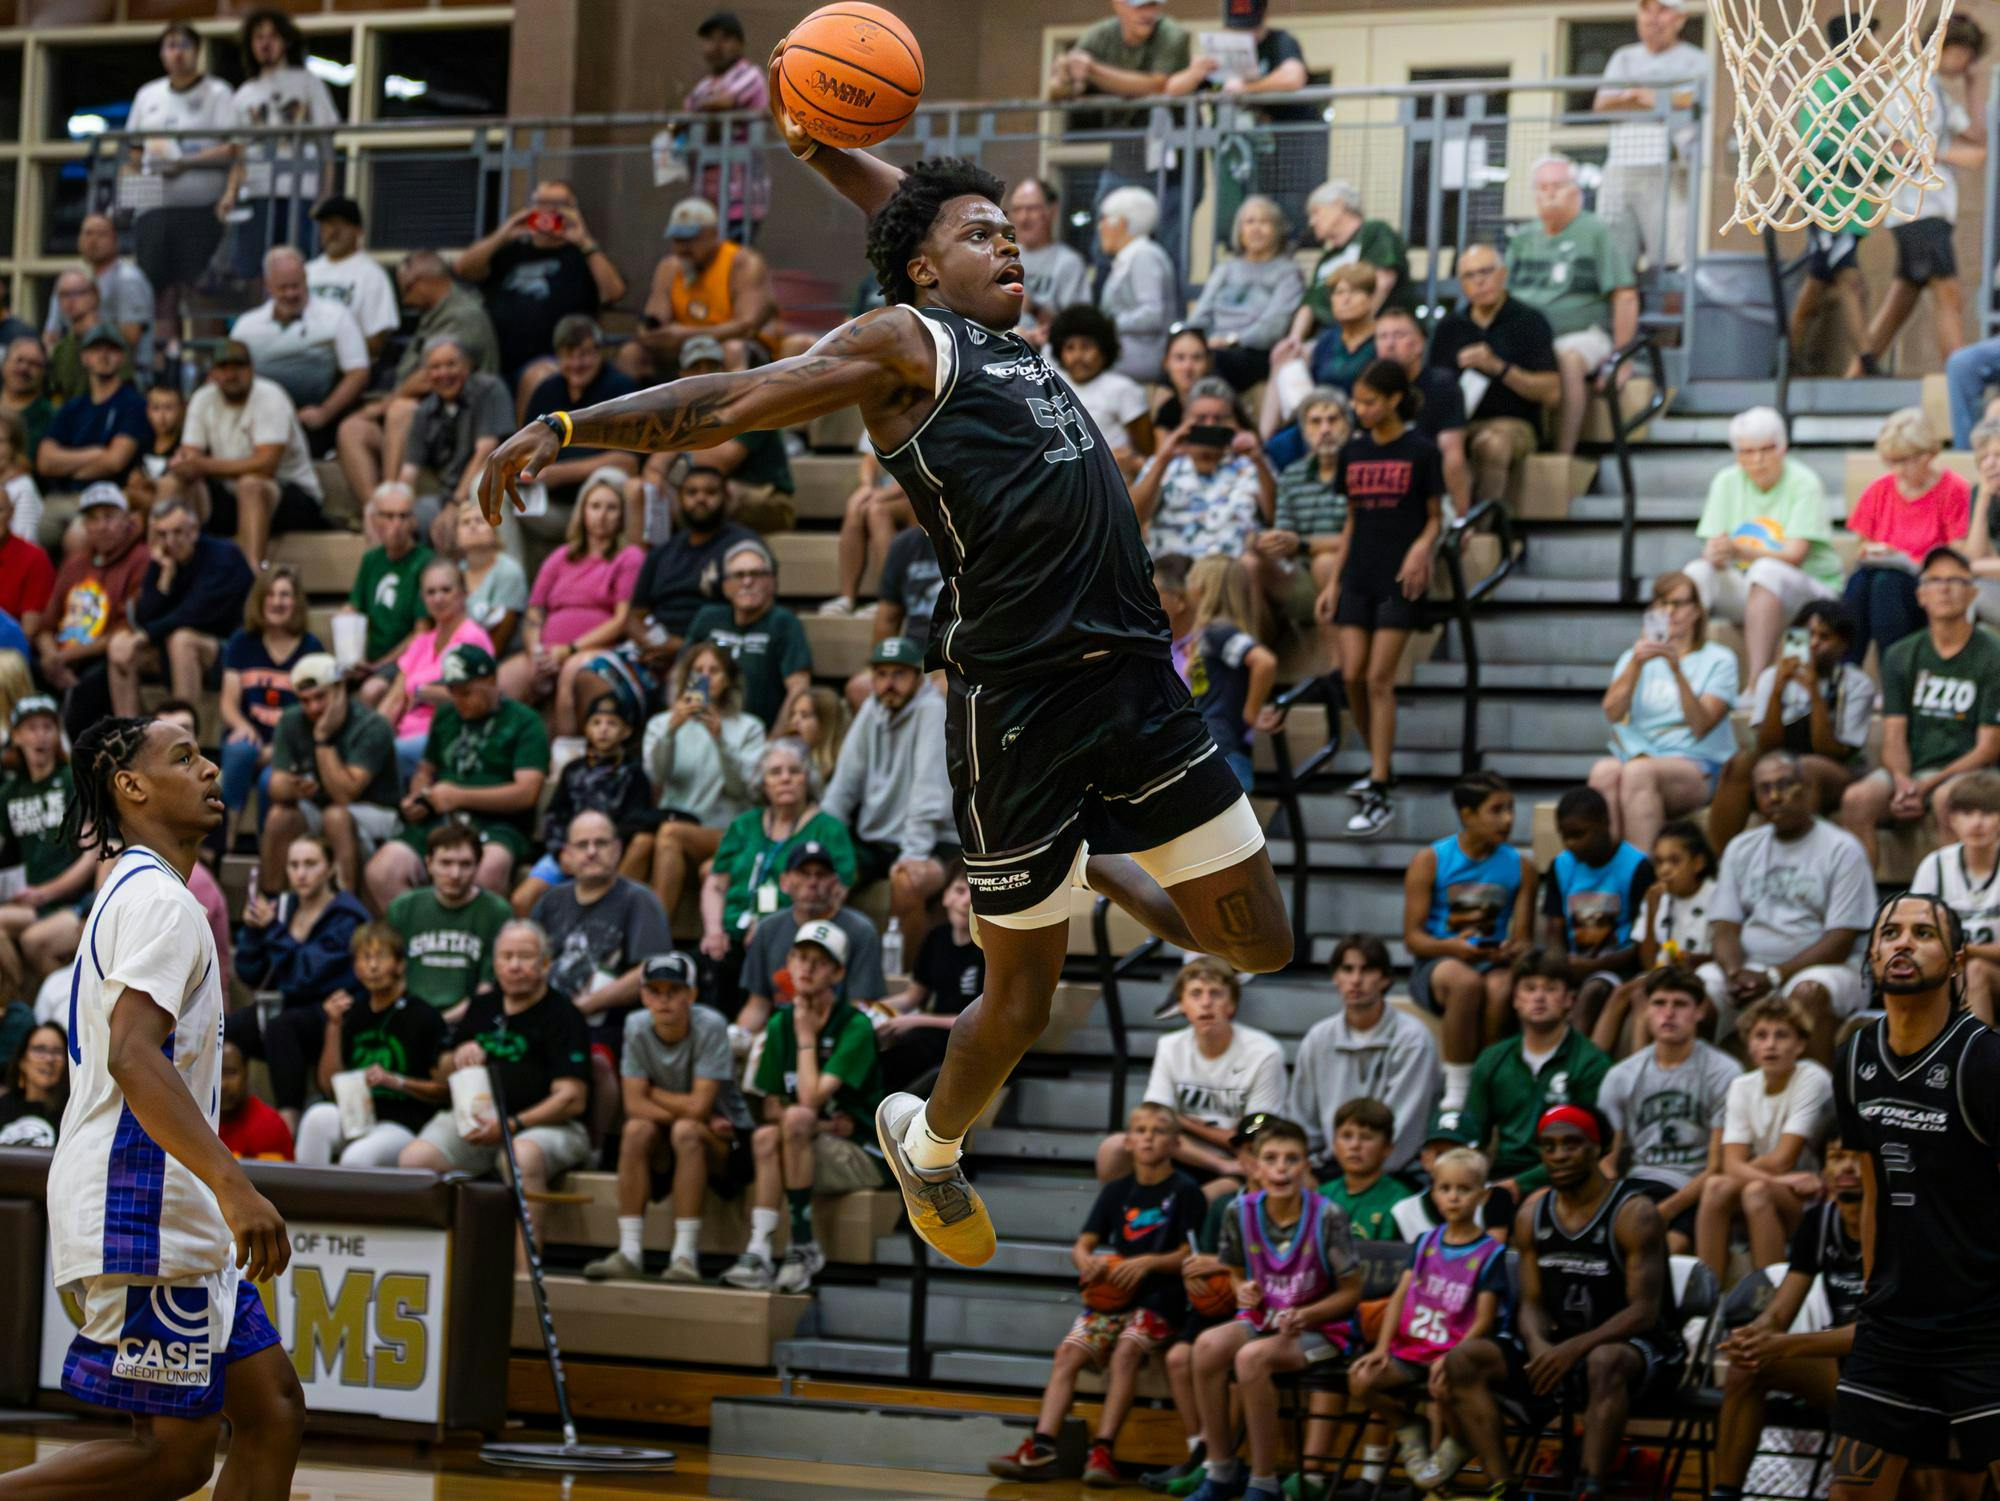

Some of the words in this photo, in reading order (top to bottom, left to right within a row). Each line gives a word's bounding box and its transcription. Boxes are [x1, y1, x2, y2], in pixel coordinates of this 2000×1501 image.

[1025, 392, 1094, 463] 55
[1913, 669, 1977, 713] IZZO
[293, 1233, 321, 1253] OF
[326, 1235, 365, 1256] THE
[1409, 1304, 1449, 1344] 25
[118, 1337, 209, 1370] CASE
[115, 1362, 160, 1380] CREDIT
[166, 1370, 208, 1384] UNION
